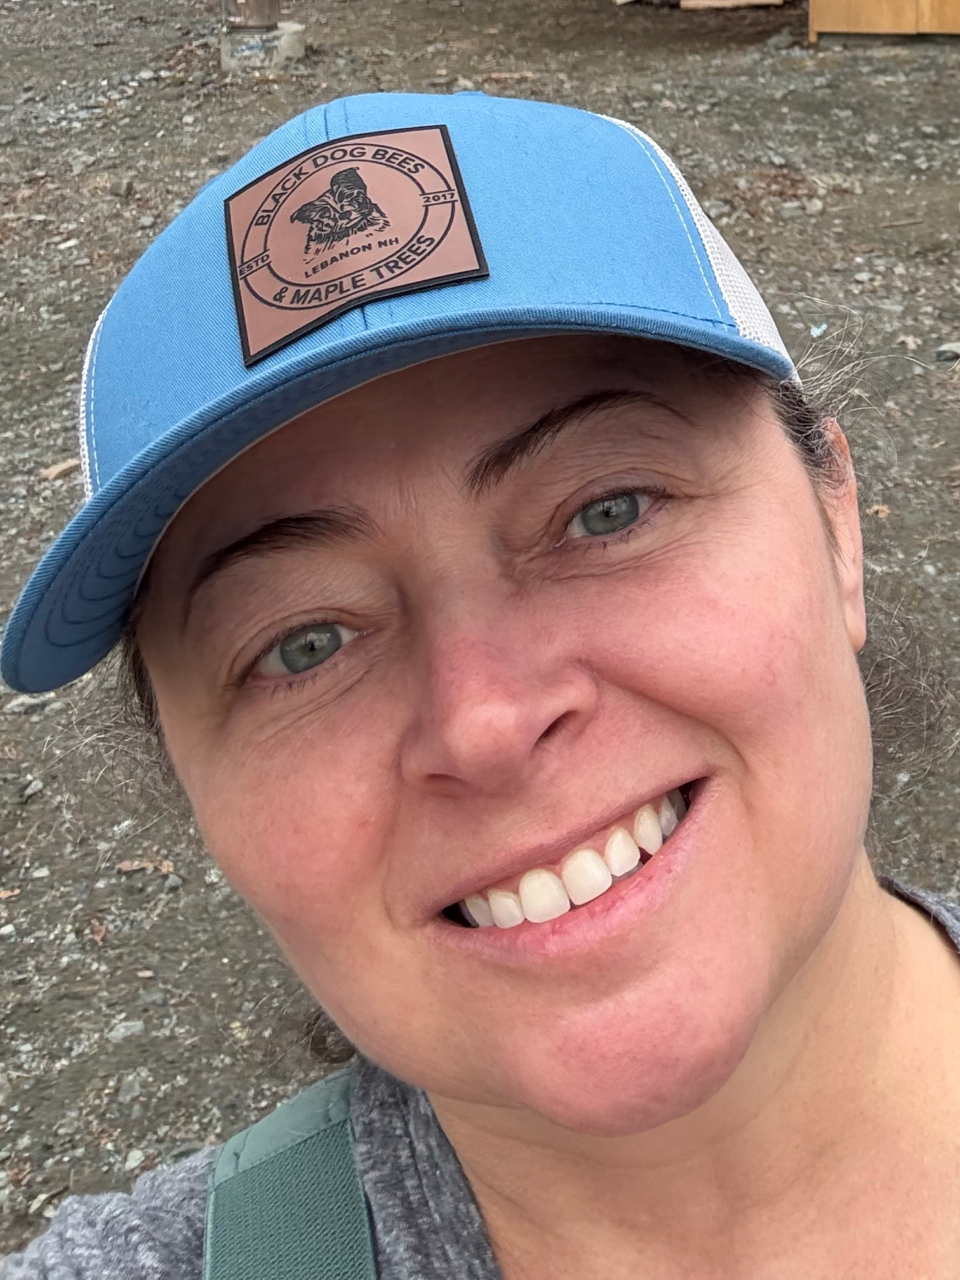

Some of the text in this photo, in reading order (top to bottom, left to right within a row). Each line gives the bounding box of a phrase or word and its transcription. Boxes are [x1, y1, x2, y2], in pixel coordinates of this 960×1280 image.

[254, 146, 426, 227] BLACK DOG BEES
[422, 192, 455, 205] 2017
[273, 234, 435, 305] & MAPLE TREES
[304, 237, 400, 279] LEBANON NH
